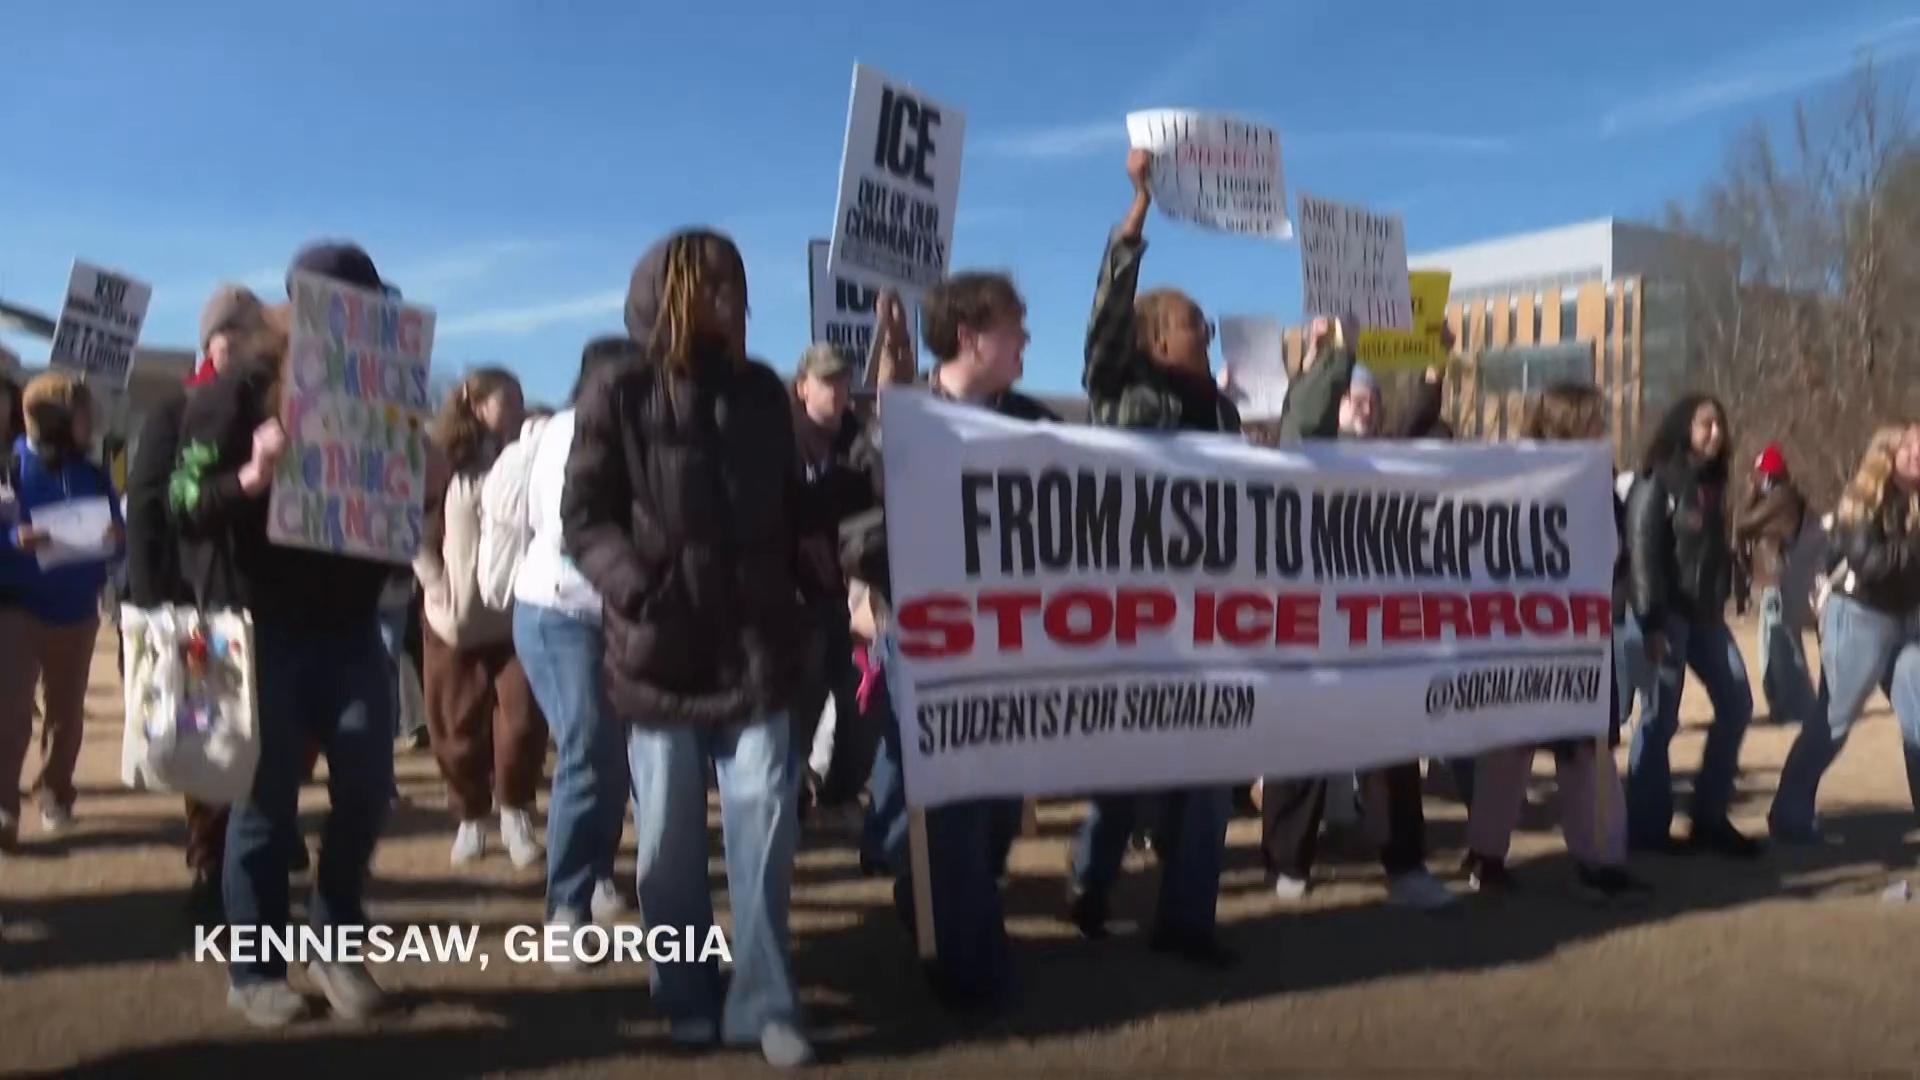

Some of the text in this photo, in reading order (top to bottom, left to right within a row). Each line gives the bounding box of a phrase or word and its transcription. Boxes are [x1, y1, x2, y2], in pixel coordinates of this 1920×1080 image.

[875, 85, 941, 192] ICE
[858, 177, 940, 236] OUT OF OUR
[961, 470, 1571, 581] FROM KSU TO MINNEAPOLIS
[897, 587, 1611, 659] STOP ICE TERROR
[917, 681, 1255, 756] STUDENTS FOR SOCIALISM
